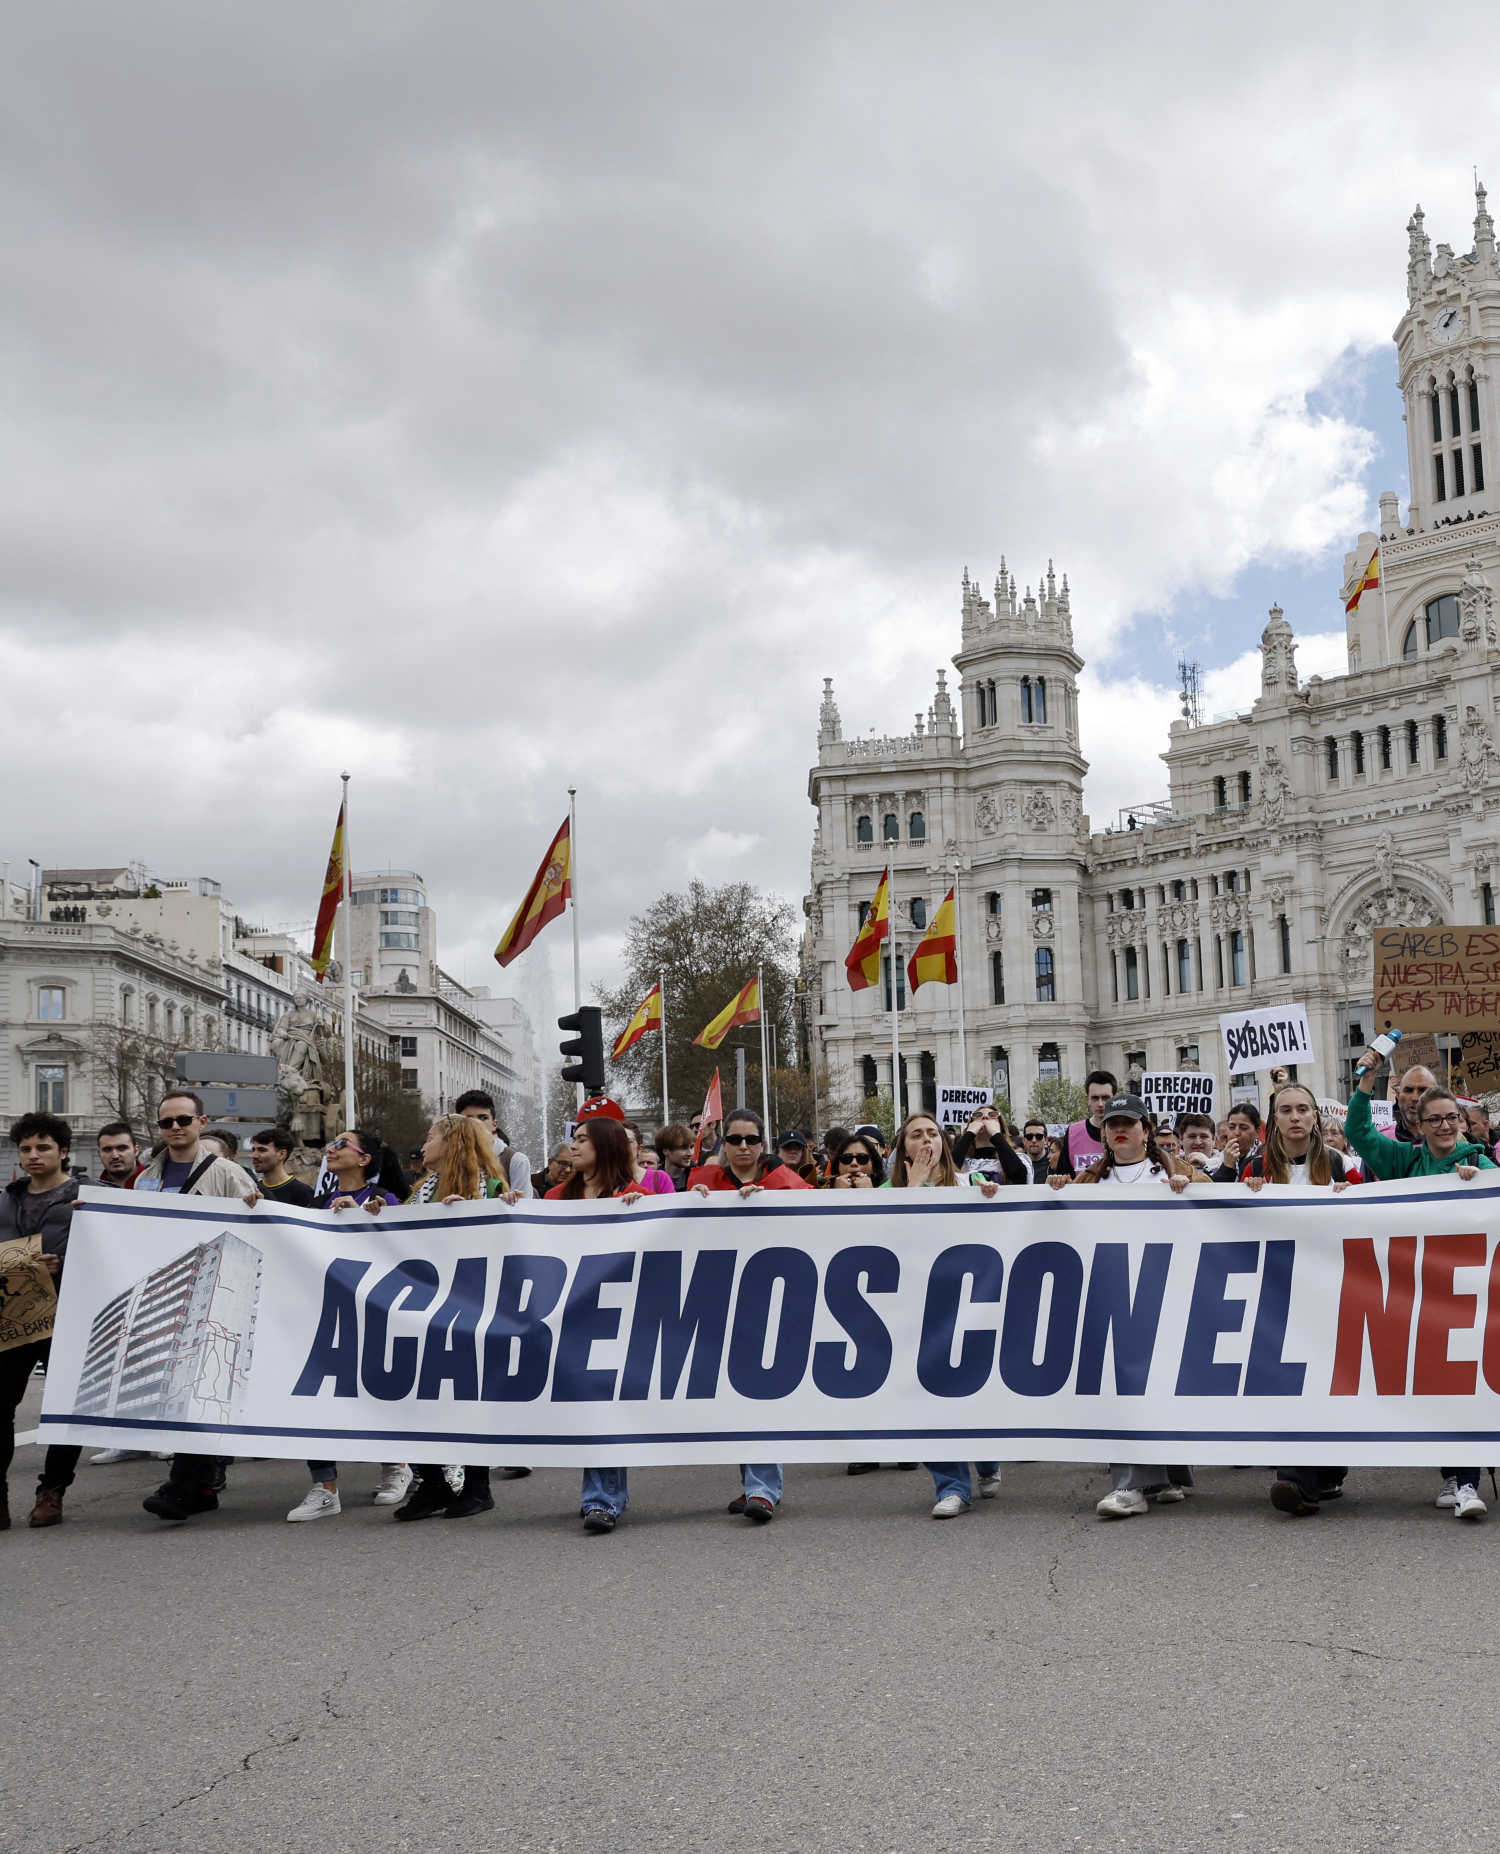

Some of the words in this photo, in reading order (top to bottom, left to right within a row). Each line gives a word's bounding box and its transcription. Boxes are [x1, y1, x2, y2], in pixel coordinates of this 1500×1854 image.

[1380, 932, 1458, 959] SAREB
[1465, 933, 1500, 957] ES
[1377, 991, 1434, 1012] CASAS
[1484, 1045, 1494, 1057] Y
[1144, 1077, 1213, 1095] DERECHO
[942, 1090, 987, 1104] DERECHO
[1145, 1096, 1153, 1112] A
[1156, 1095, 1212, 1114] TECHO
[943, 1110, 950, 1122] A
[291, 1247, 900, 1401] ACABEMOS
[917, 1242, 1173, 1397] CON
[1175, 1240, 1307, 1396] EL
[0, 1328, 24, 1342] DEL
